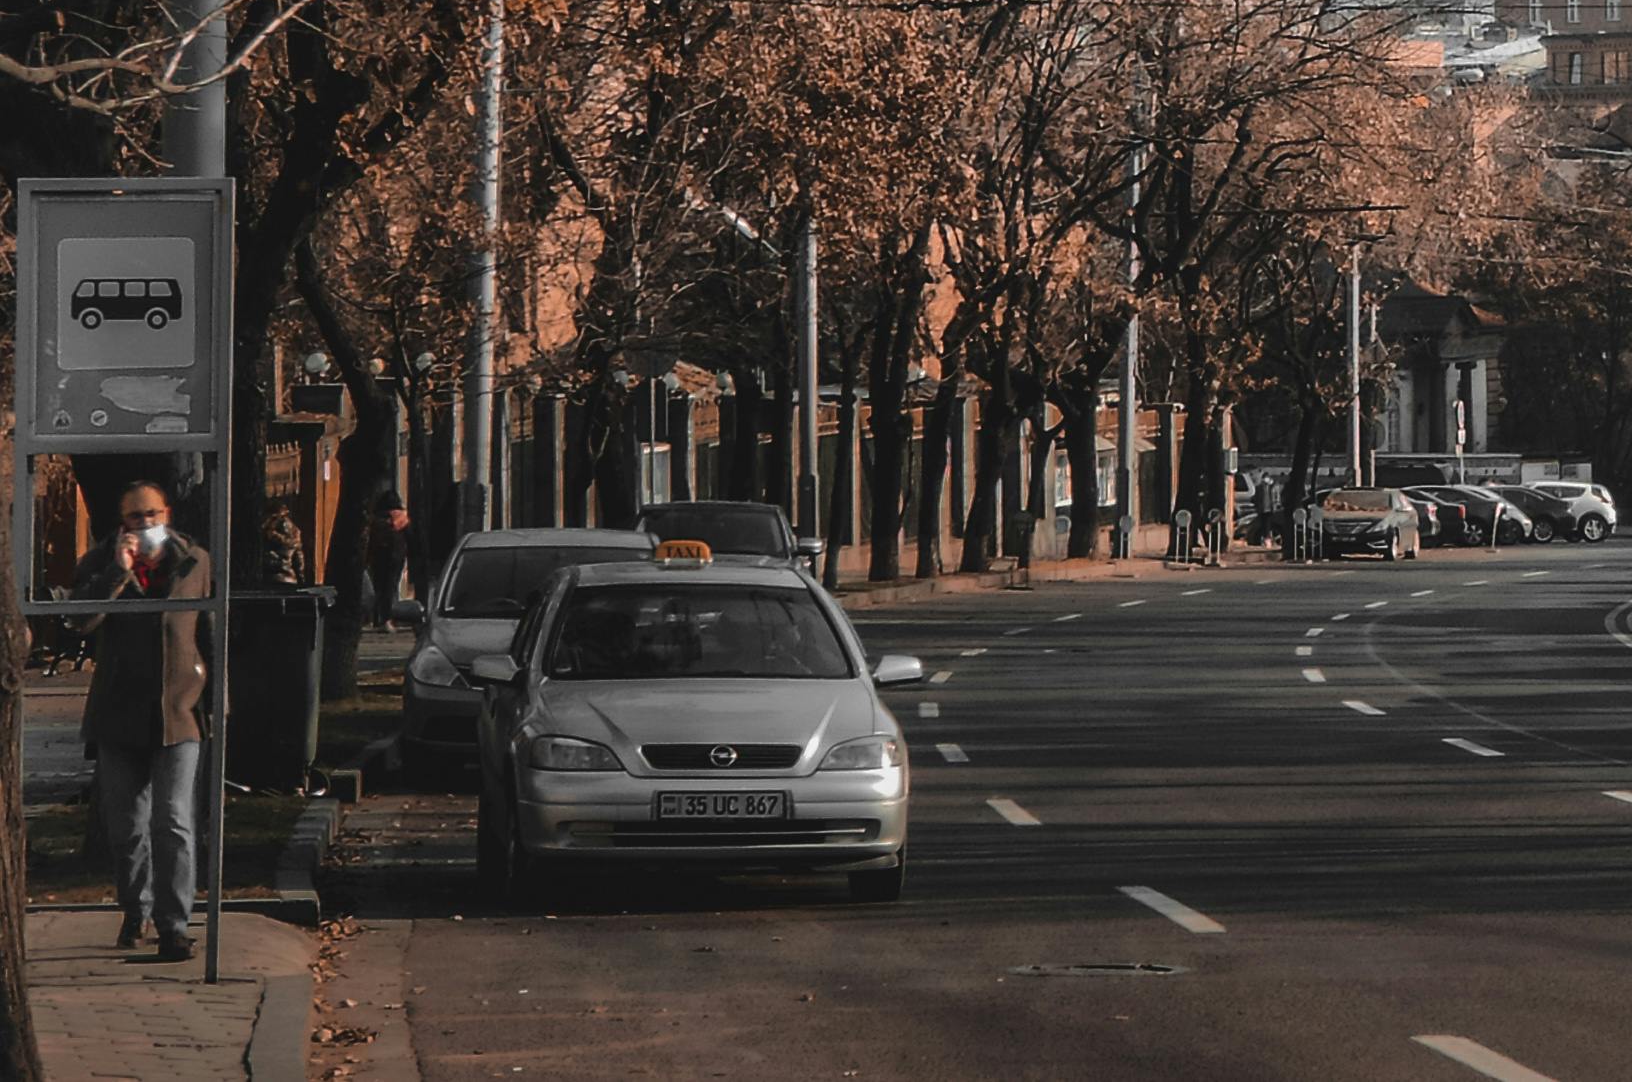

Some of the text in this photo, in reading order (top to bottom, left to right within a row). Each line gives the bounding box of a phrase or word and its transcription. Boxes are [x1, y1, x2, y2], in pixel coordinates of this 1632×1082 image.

[666, 546, 701, 558] TAXI
[685, 795, 778, 815] 35 UC 867
